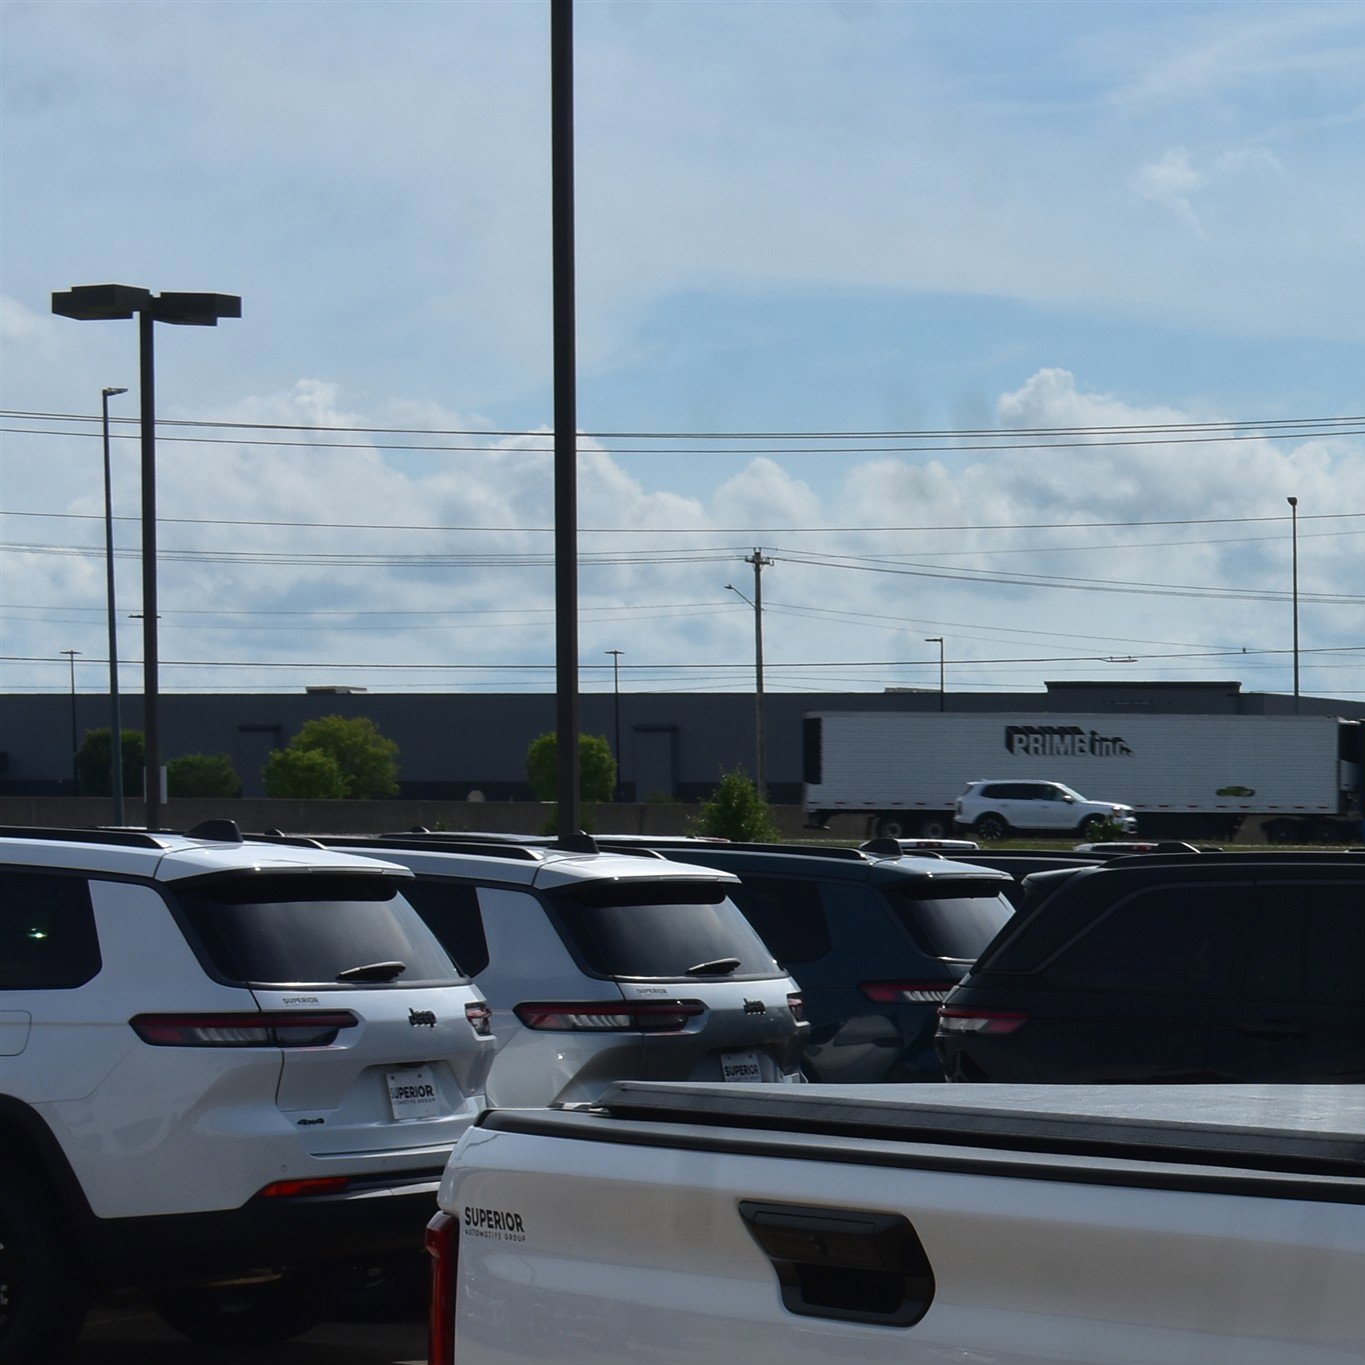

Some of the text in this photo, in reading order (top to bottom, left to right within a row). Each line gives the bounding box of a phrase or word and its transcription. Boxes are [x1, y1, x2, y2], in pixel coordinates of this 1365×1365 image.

[1006, 726, 1087, 756] PRIME
[408, 1007, 437, 1028] Jeep
[725, 1064, 758, 1077] SUPERIOR
[465, 1206, 525, 1232] SUPERIOR
[465, 1229, 526, 1242] AUTOMOTIVE GROUP
